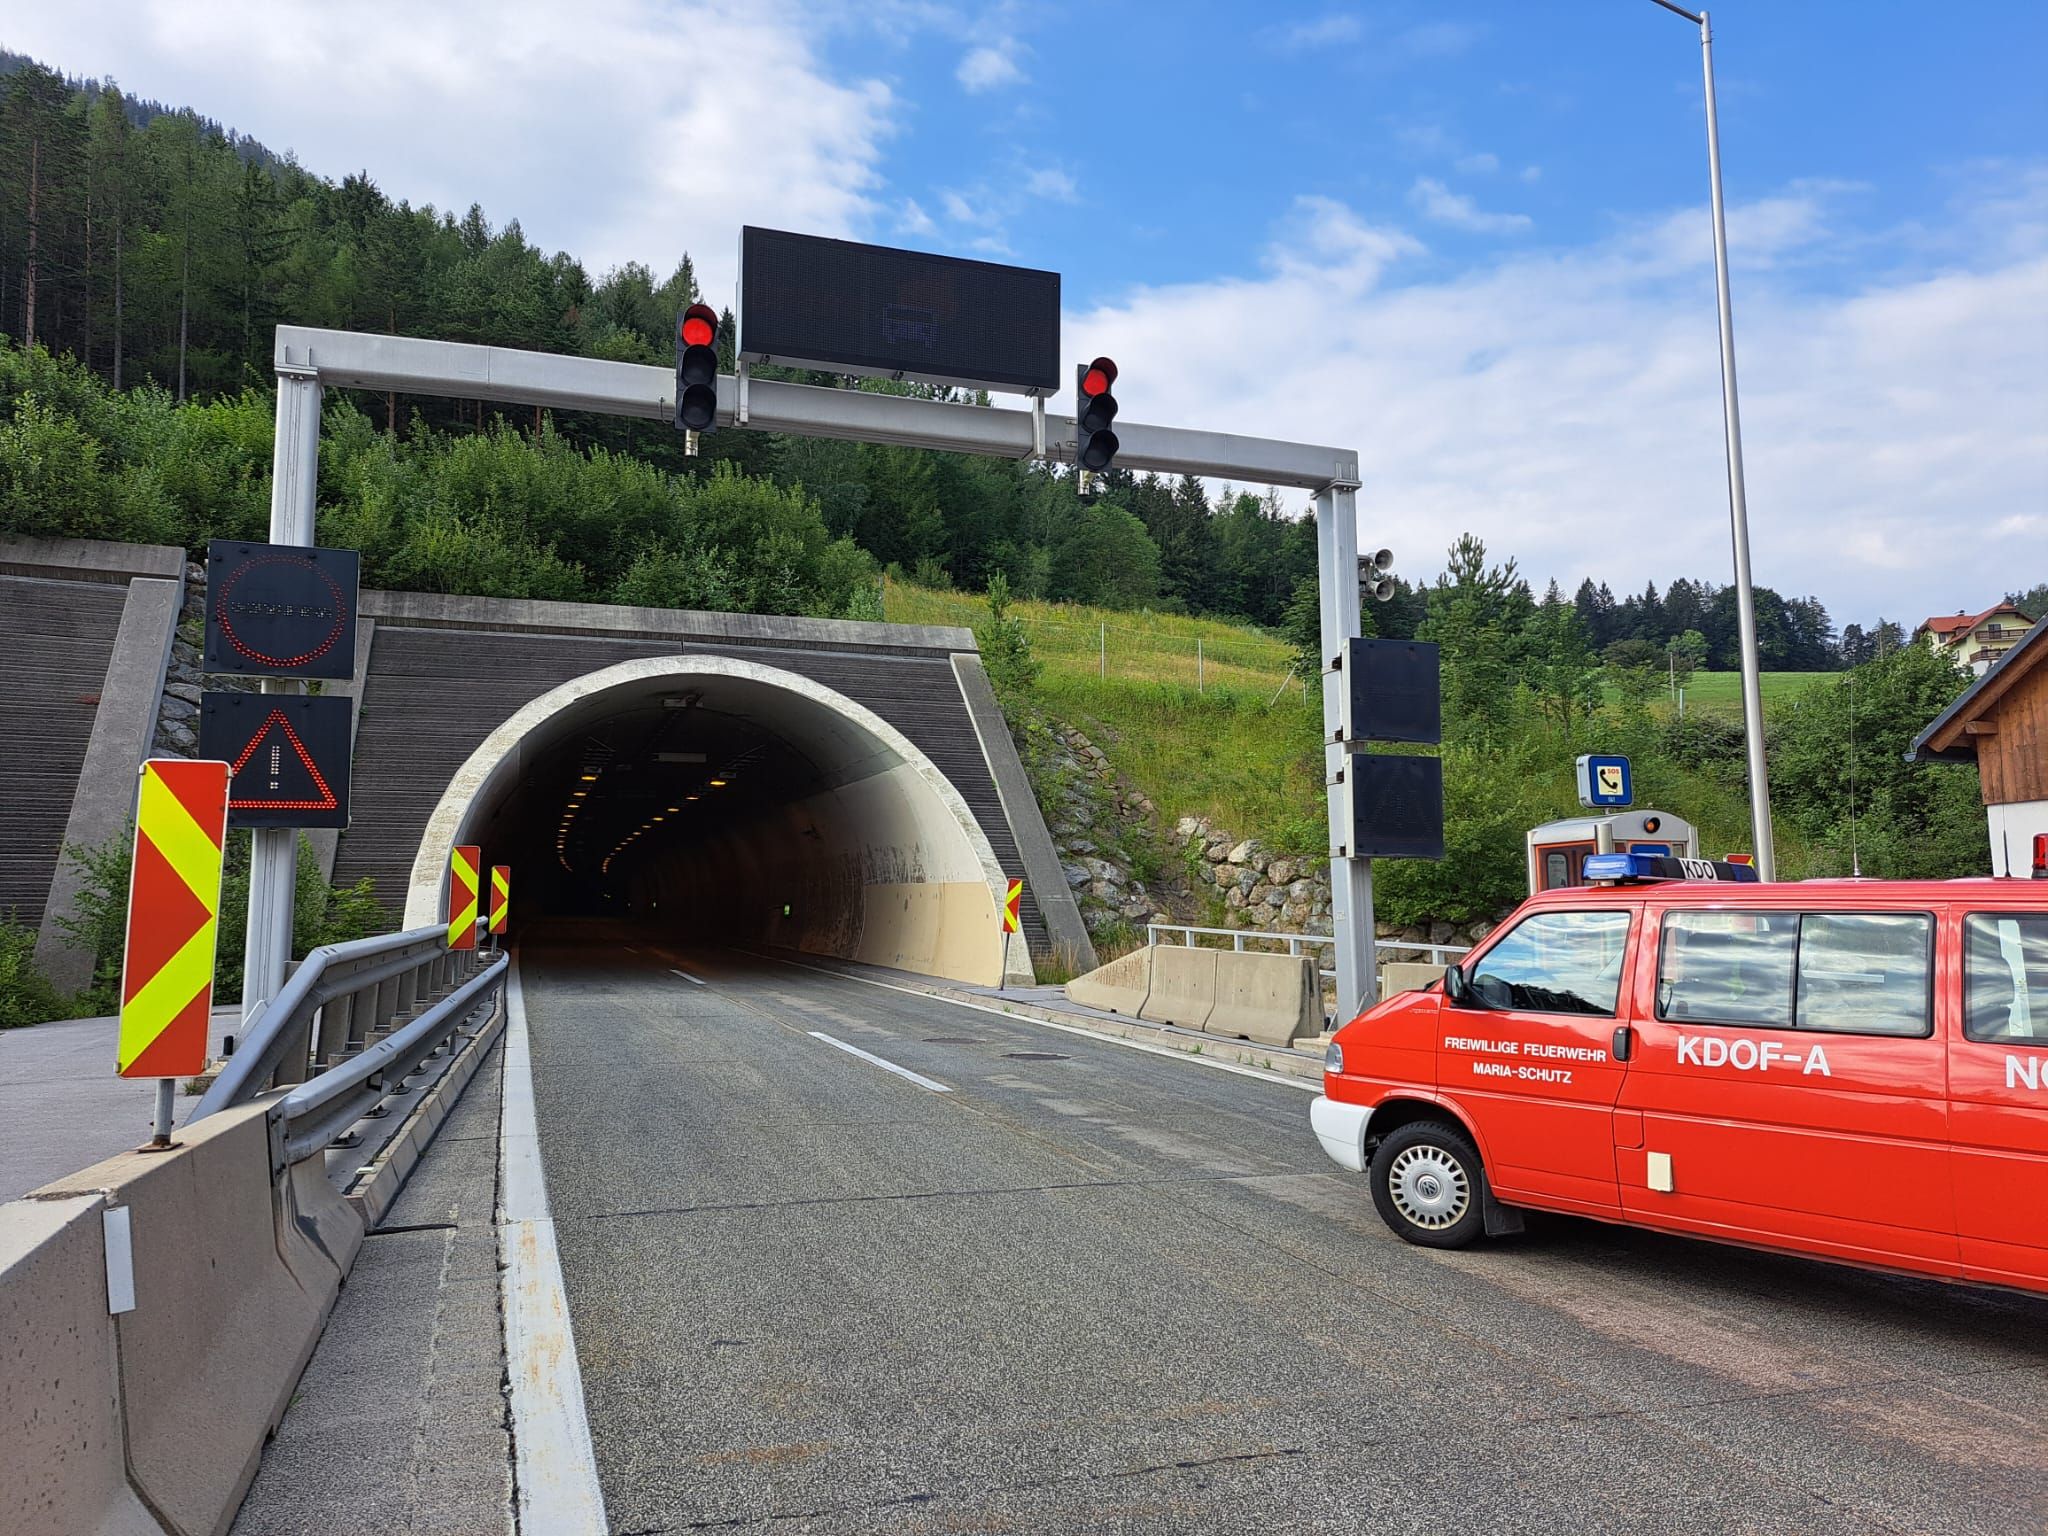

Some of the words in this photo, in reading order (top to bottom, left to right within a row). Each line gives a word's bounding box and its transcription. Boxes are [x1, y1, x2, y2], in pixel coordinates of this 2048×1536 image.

[1682, 859, 1714, 880] KDO
[1444, 1036, 1519, 1055] FREIWILLIGE
[1523, 1043, 1607, 1062] FEUERWEHR
[1677, 1035, 1831, 1077] KDOF-A
[1473, 1062, 1573, 1083] MARIA-SCHUTZ
